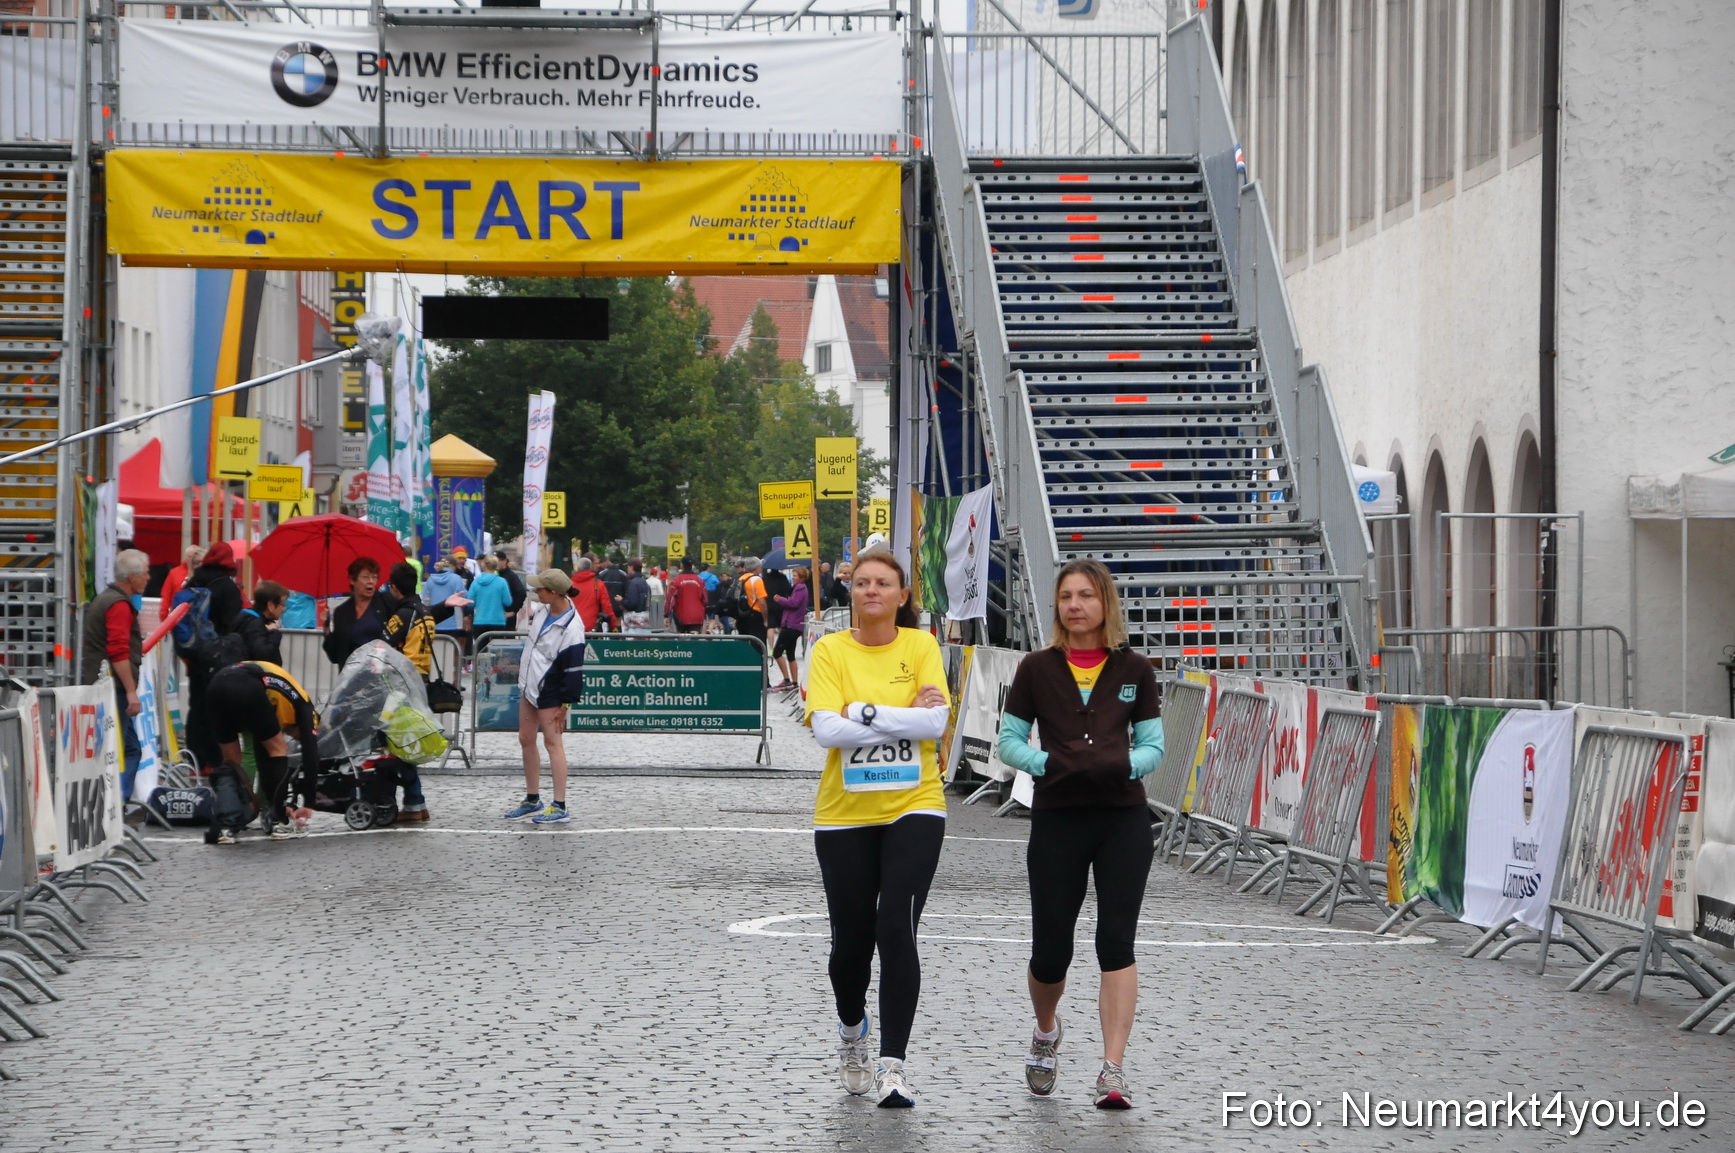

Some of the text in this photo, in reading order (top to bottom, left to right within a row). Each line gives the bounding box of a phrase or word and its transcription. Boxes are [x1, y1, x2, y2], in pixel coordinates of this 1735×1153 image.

[356, 51, 759, 88] BMW EfficientDynamics
[357, 84, 761, 109] Weniger Verbrauch. Mehr Fahrfreude.
[151, 206, 324, 224] Neumarkter Stadtlauf
[371, 179, 640, 240] START
[689, 215, 856, 230] Neumarkter Stadtlauf
[219, 434, 258, 445] Jugend-
[229, 446, 248, 456] lauf
[817, 454, 855, 466] Jugend-
[828, 466, 845, 475] lauf
[257, 475, 299, 485] chnupper-
[547, 502, 559, 519] B
[876, 508, 887, 525] B
[792, 524, 811, 548] A
[671, 540, 681, 553] C
[705, 550, 713, 561] D
[603, 649, 693, 659] Event-Leit-Systeme
[610, 674, 622, 688] &
[626, 673, 676, 688] Action
[680, 674, 695, 688] in
[577, 692, 708, 706] sicheren Bahnen!
[577, 716, 723, 726] Miet & Service Line: 09181 6352
[850, 738, 913, 765] 2258
[864, 769, 899, 781] Kerstin
[158, 790, 204, 806] REEBOK
[166, 802, 193, 814] 1983
